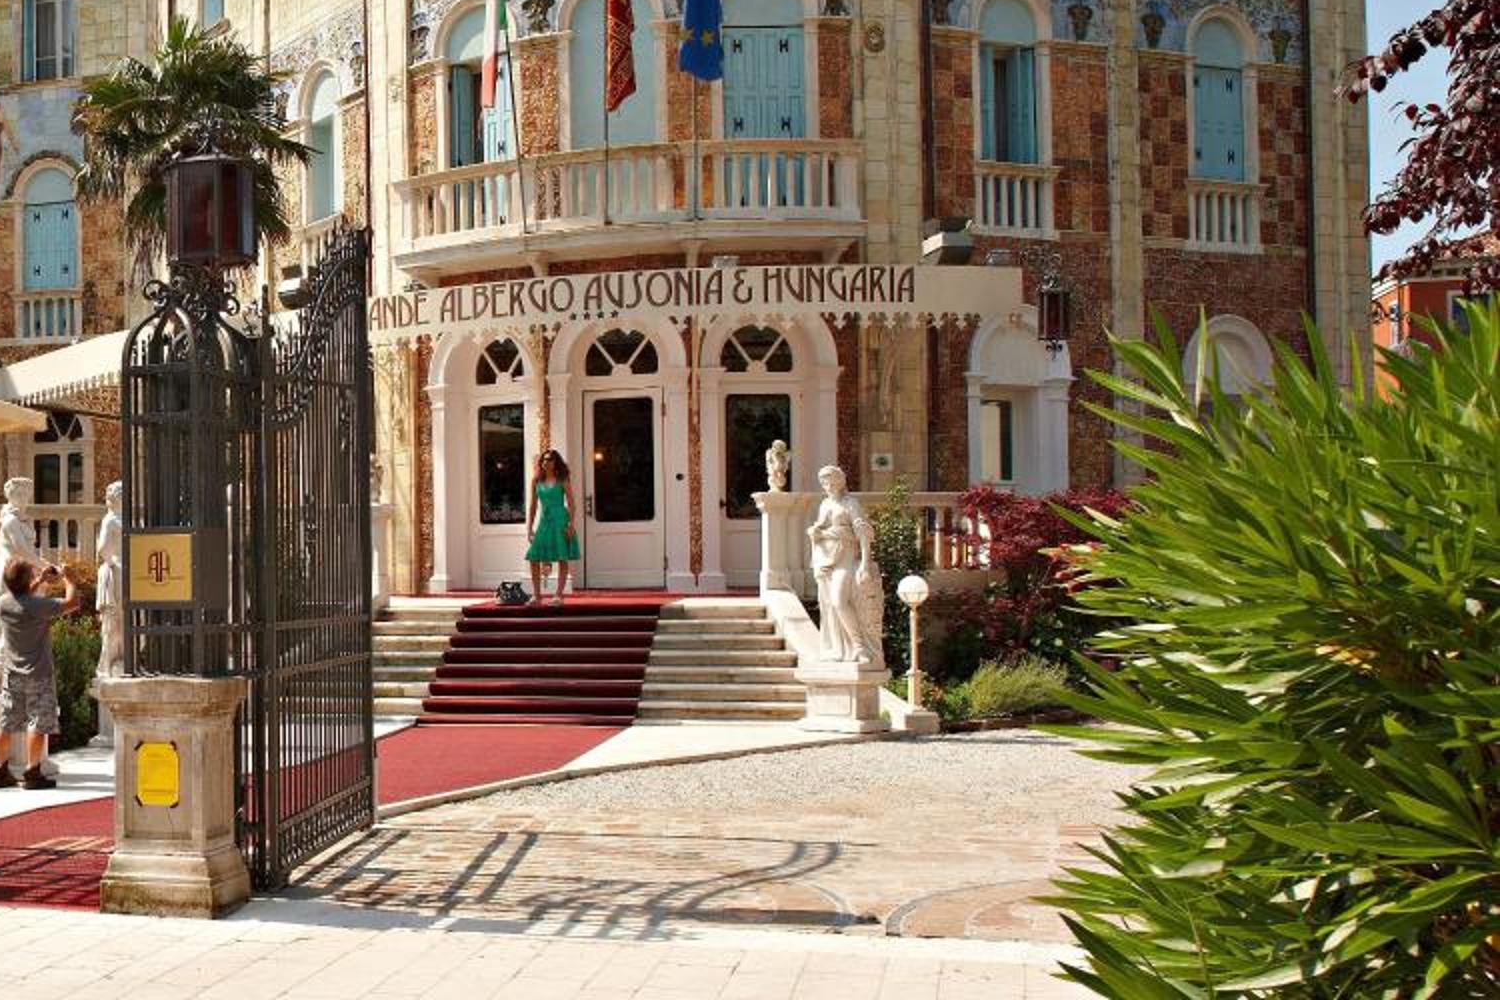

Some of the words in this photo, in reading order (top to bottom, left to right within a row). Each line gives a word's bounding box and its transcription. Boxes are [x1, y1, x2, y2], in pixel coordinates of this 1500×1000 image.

[369, 292, 431, 332] ANDE
[440, 277, 575, 323] ALBERGO
[583, 268, 724, 311] AUSONIA
[732, 268, 753, 305] &
[763, 266, 916, 304] HUNGARIA
